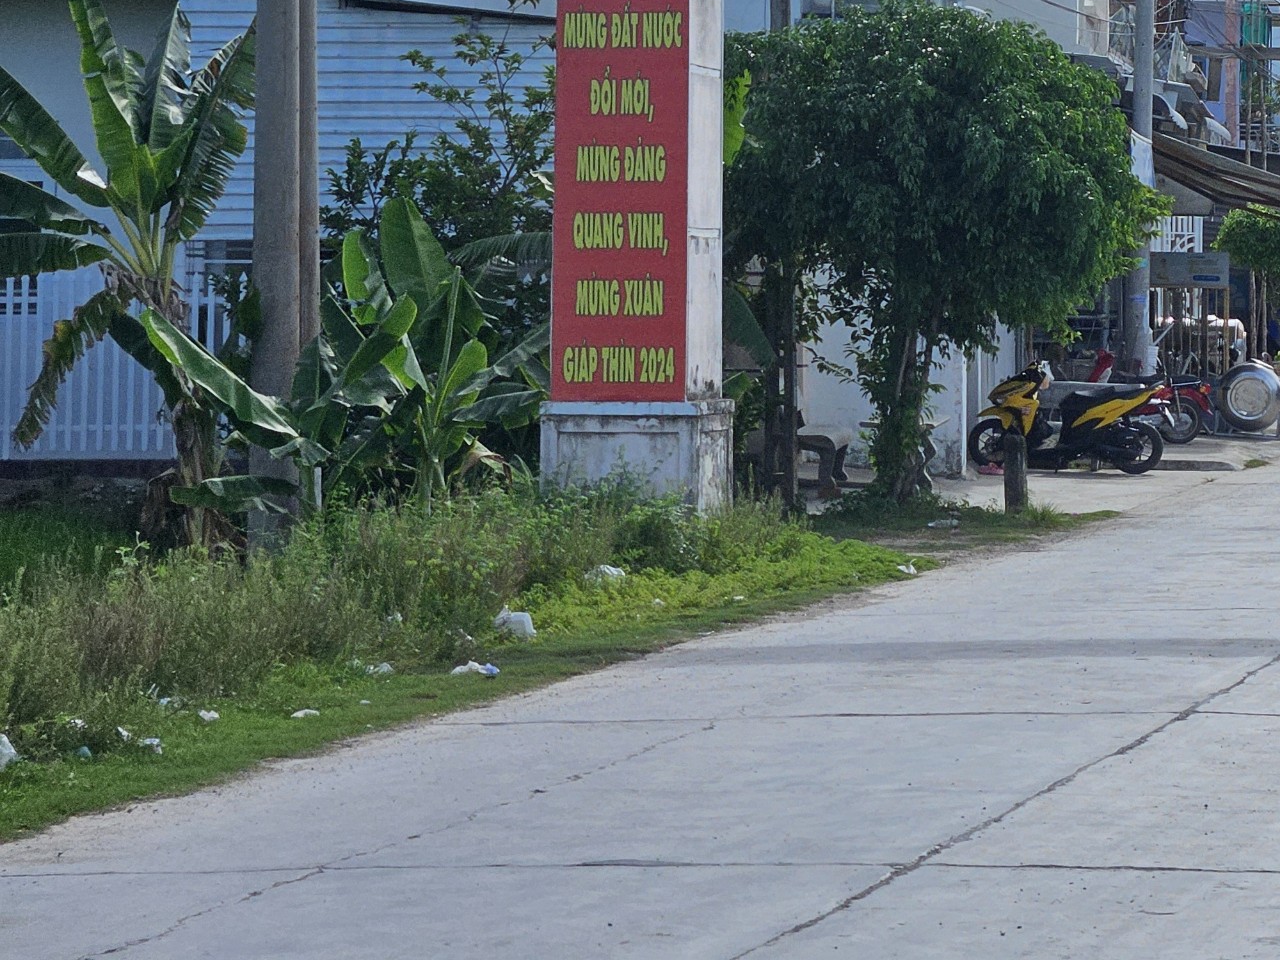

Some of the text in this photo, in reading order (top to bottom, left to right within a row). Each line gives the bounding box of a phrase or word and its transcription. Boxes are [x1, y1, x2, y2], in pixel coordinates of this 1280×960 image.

[563, 1, 682, 48] MỪNG ĐẤT NƯỚC
[590, 65, 654, 122] ĐỔI MỚI,
[576, 136, 666, 182] MỪNG ĐẢNG
[573, 212, 669, 256] QUANG VINH,
[576, 272, 663, 316] MỪNG XUÂN
[563, 339, 675, 383] GIÁP THÌN 2024
